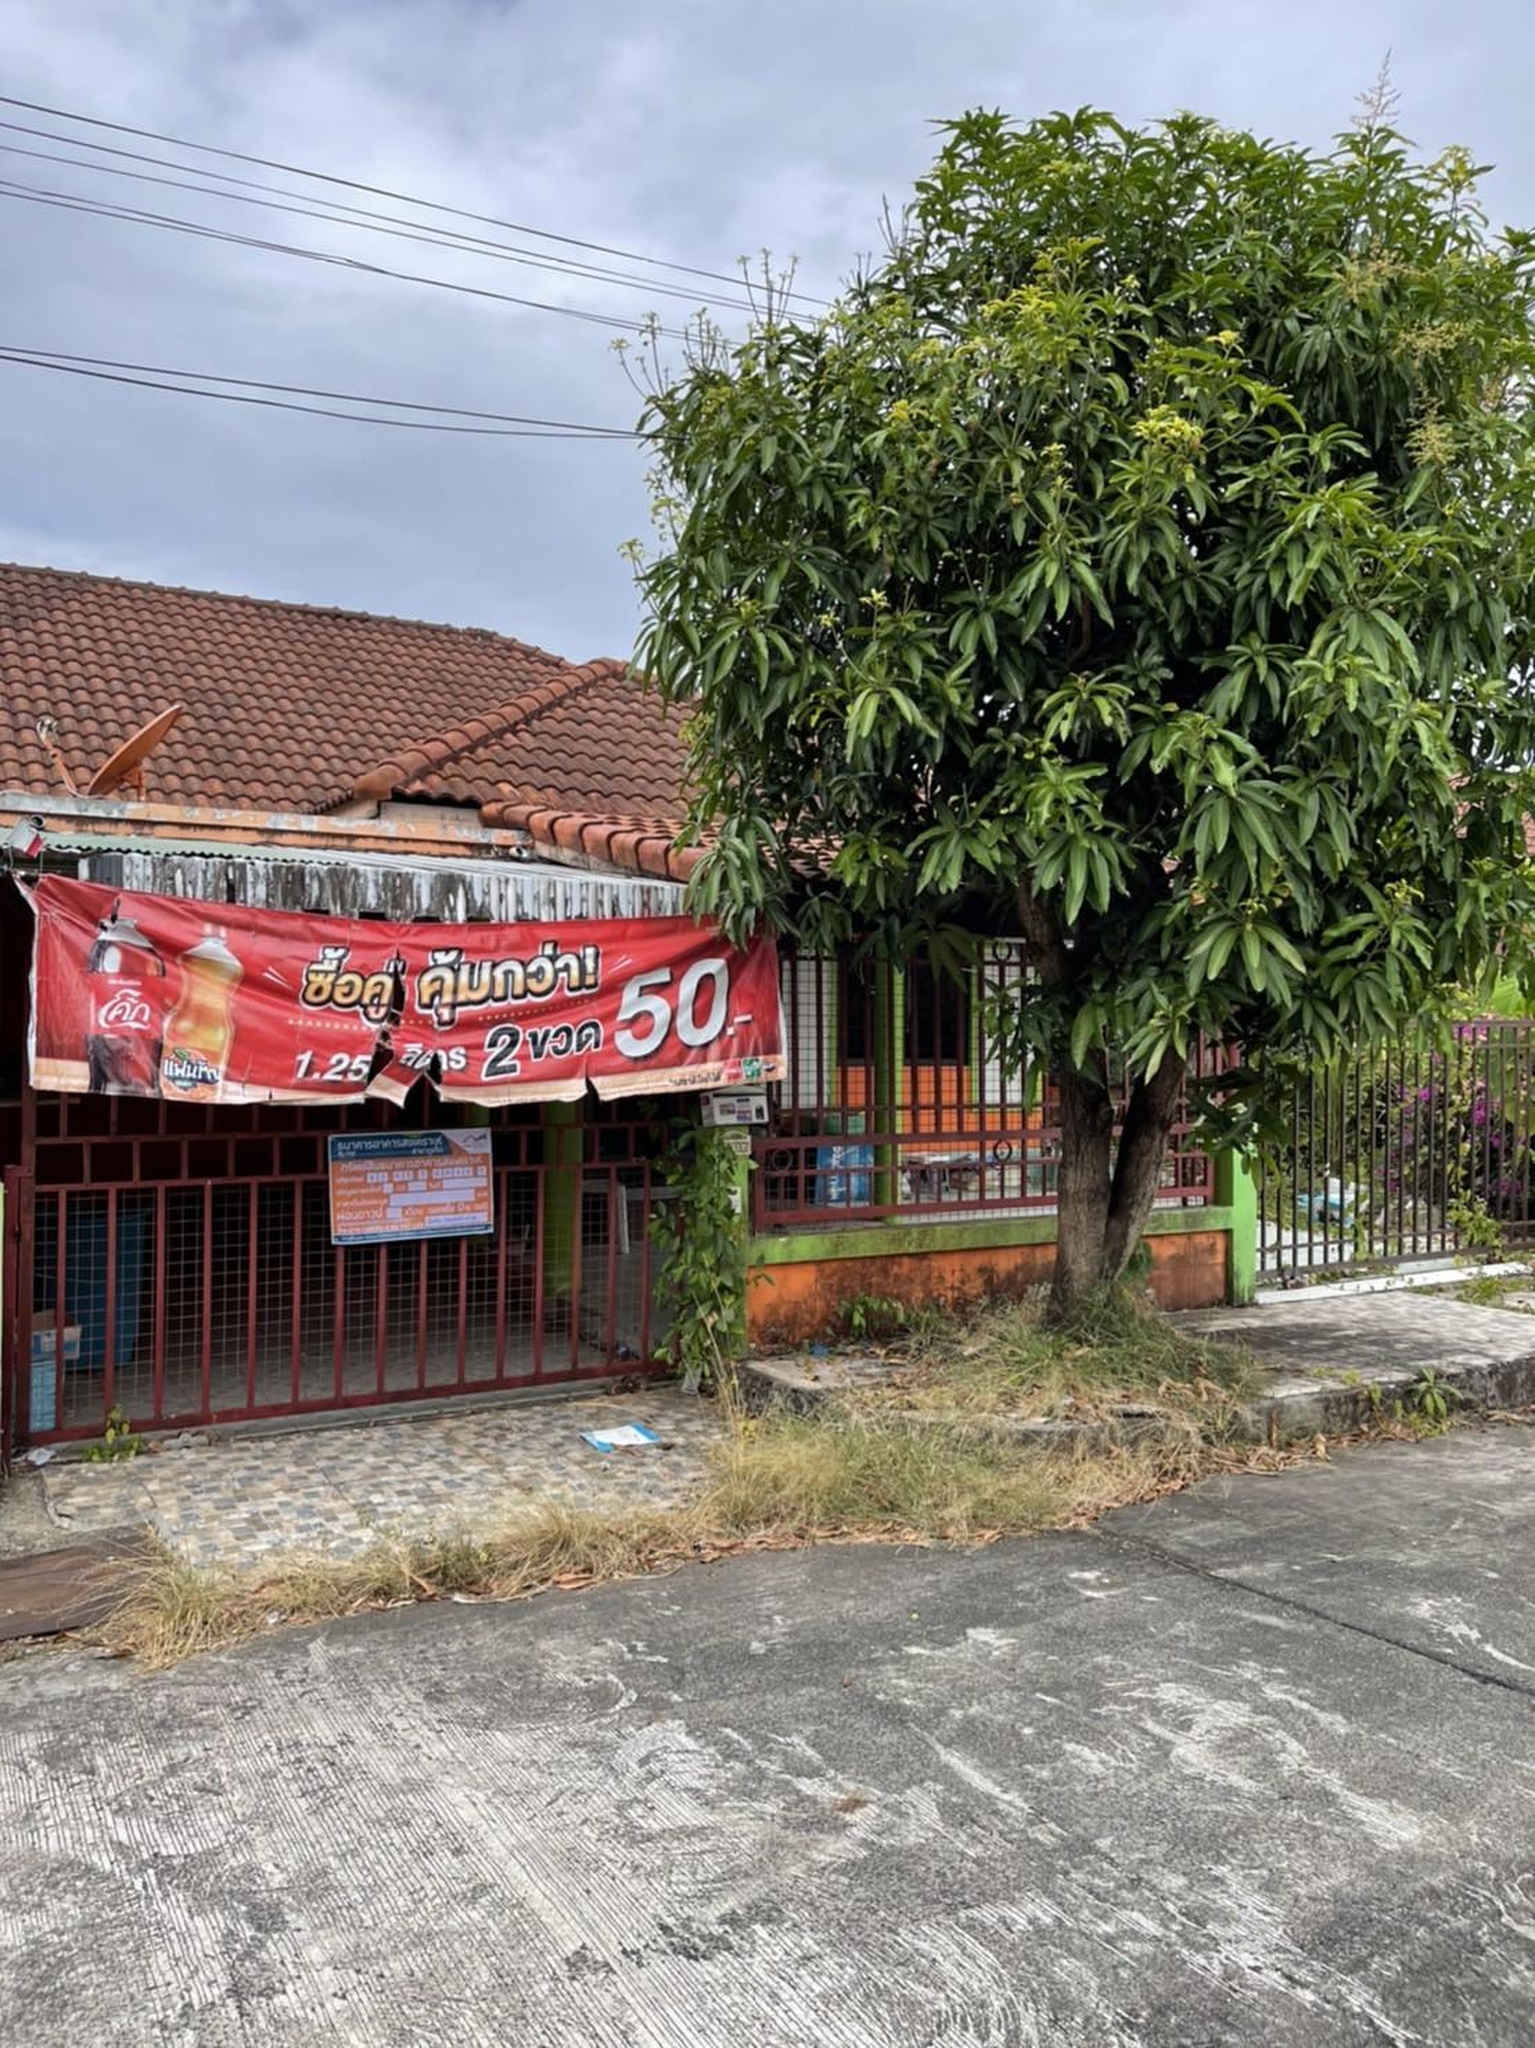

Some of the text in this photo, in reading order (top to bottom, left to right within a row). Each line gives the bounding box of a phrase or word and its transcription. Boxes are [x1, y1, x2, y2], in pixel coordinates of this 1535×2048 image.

[415, 941, 600, 1027] คุ้มกว่า!
[296, 1050, 373, 1082] 1.25
[482, 1022, 522, 1081] 2
[528, 1020, 605, 1062] ขวด
